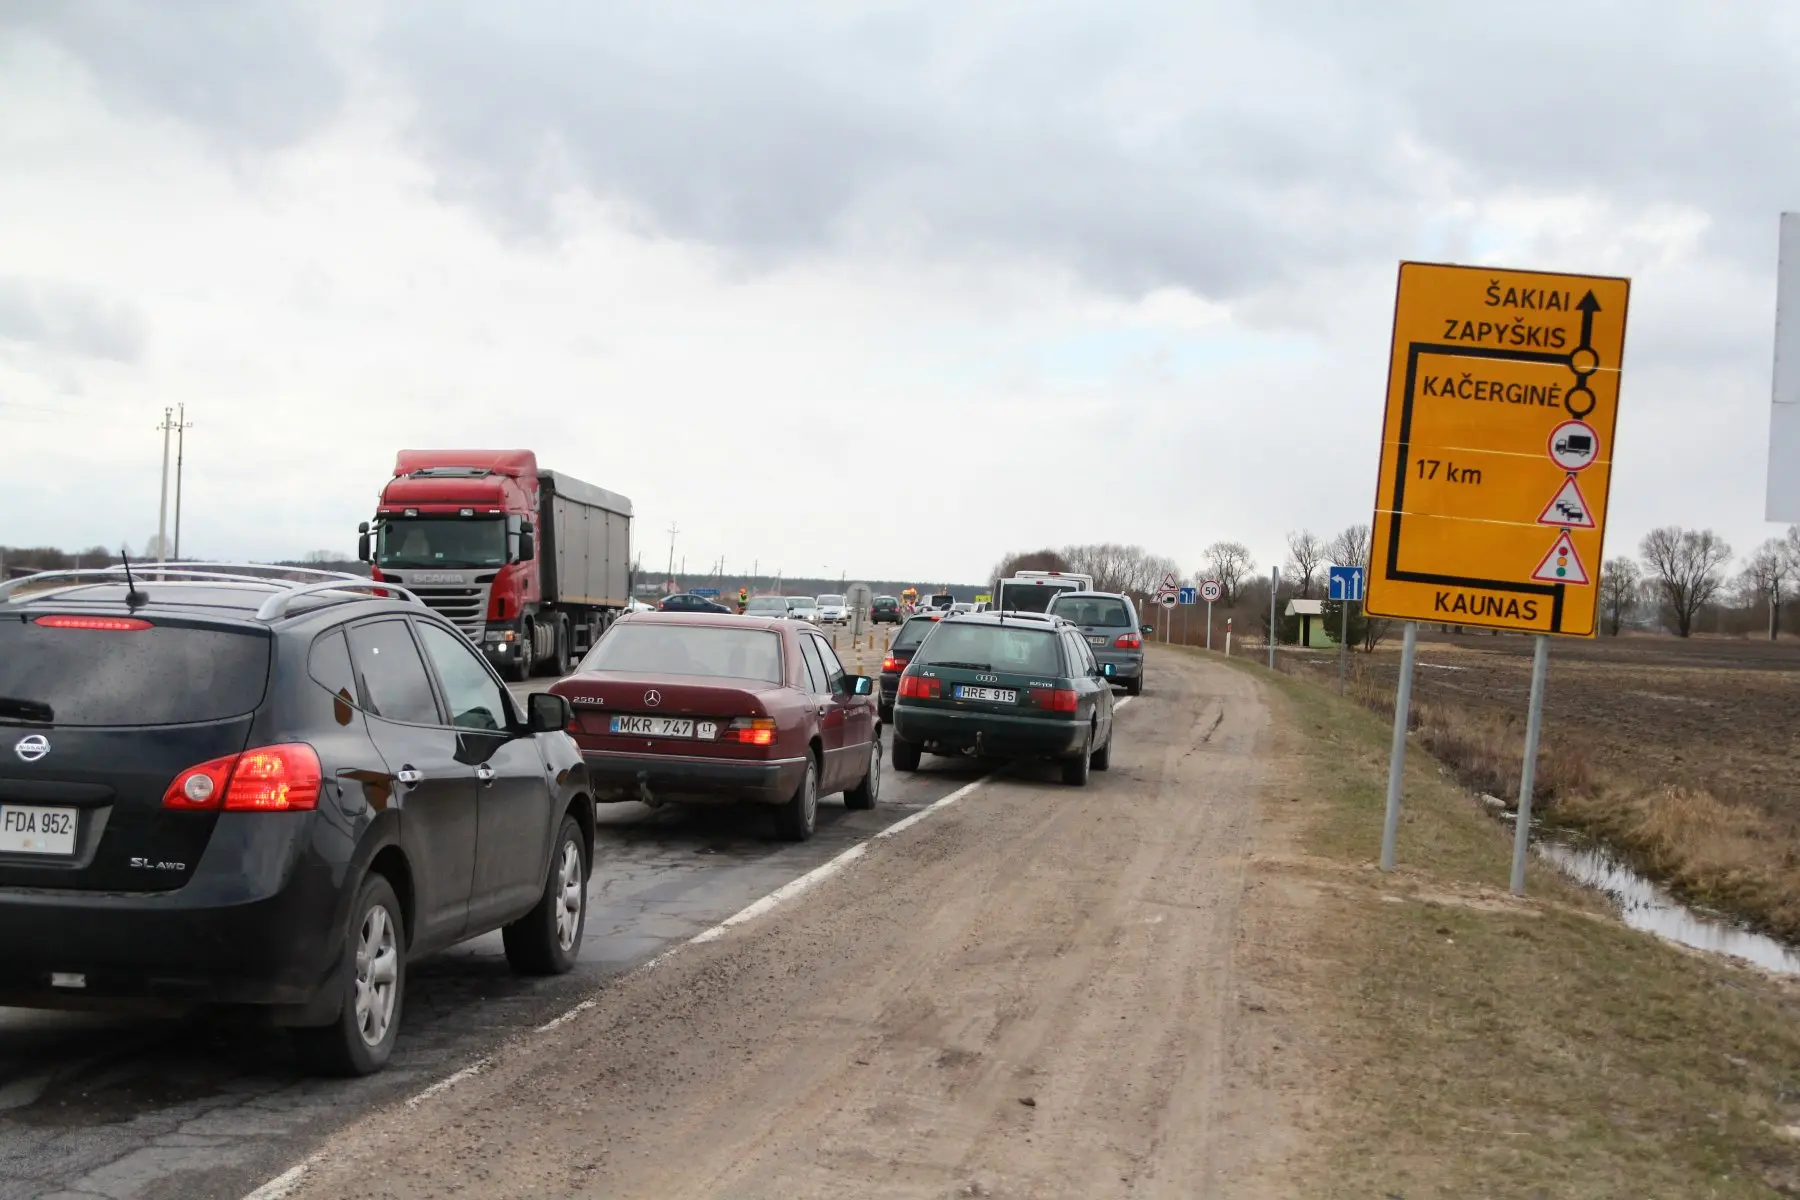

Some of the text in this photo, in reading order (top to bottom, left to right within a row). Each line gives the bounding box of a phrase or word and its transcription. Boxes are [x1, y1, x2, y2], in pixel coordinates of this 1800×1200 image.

[1484, 279, 1570, 312] ŠAKIAI
[1443, 316, 1566, 348] ZAPYŠKIS
[1423, 372, 1562, 408] KAČERGINĖ
[1416, 459, 1481, 485] 17 km
[413, 573, 464, 583] SCANIA
[1205, 586, 1217, 595] 50
[1434, 592, 1538, 621] KAUNAS
[962, 686, 987, 699] HRE
[993, 690, 1014, 701] 915
[620, 717, 690, 734] MKR 747
[702, 723, 713, 732] LT
[5, 811, 69, 835] FDA 952
[130, 857, 186, 870] SL AWD
